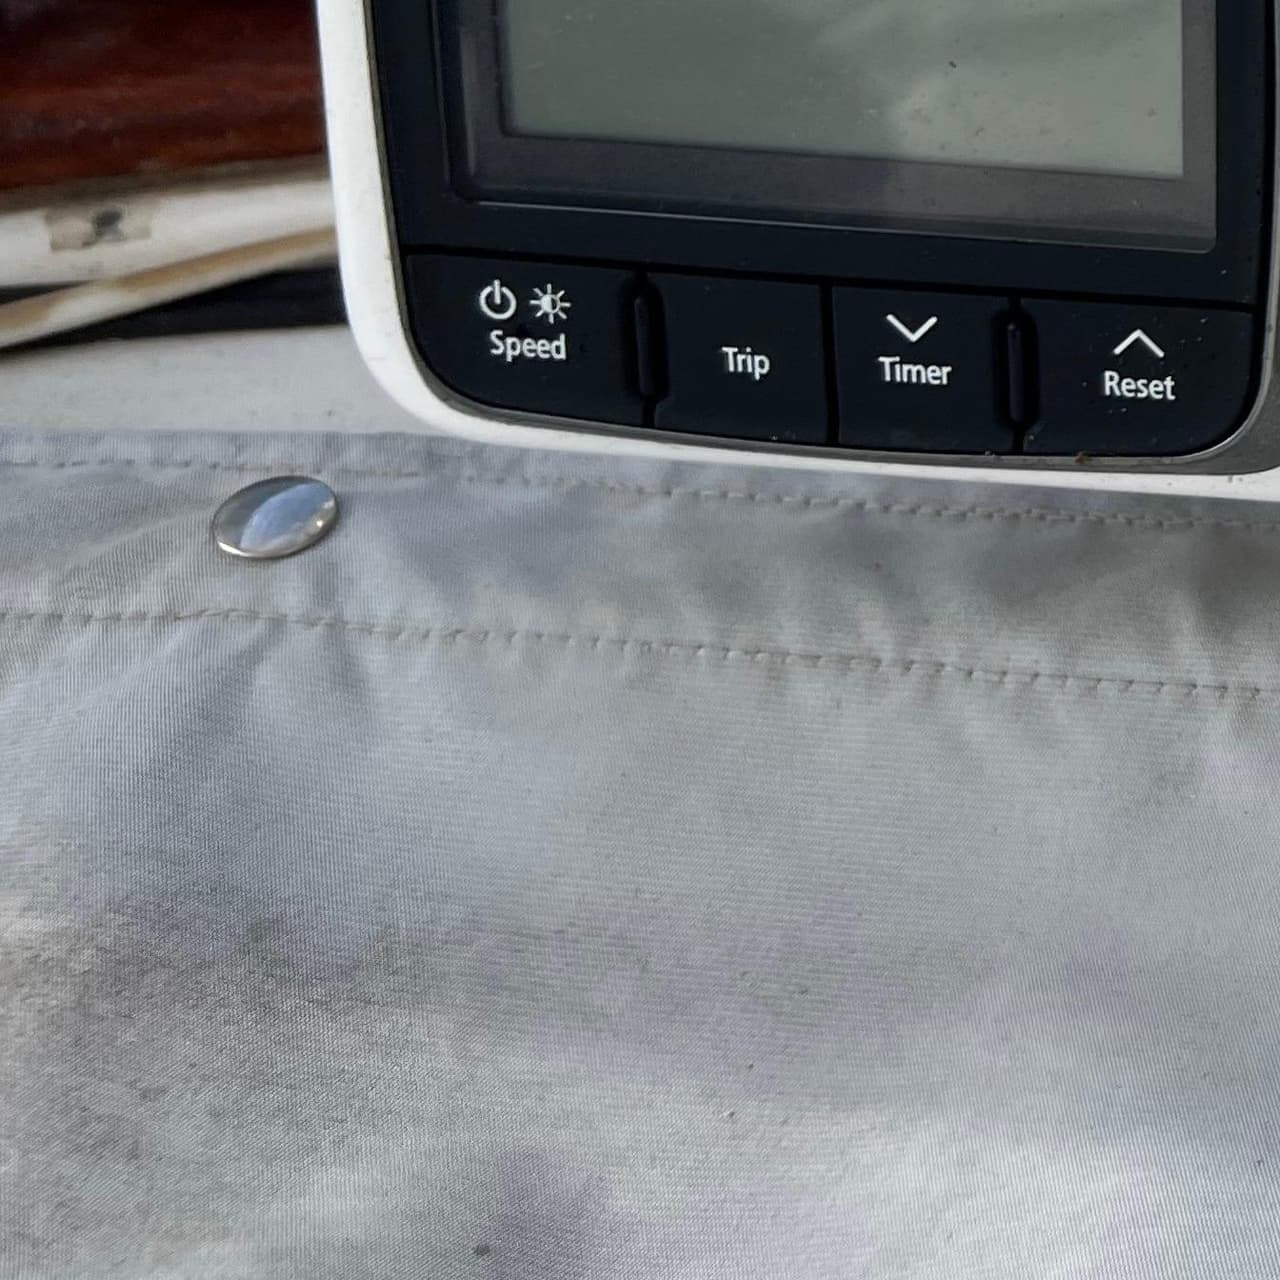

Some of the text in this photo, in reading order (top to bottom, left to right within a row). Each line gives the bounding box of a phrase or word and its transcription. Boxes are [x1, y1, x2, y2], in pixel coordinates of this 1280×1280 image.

[489, 329, 567, 362] Speed
[721, 346, 770, 381] Trip
[877, 356, 952, 385] Timer
[1103, 370, 1176, 401] Reset
